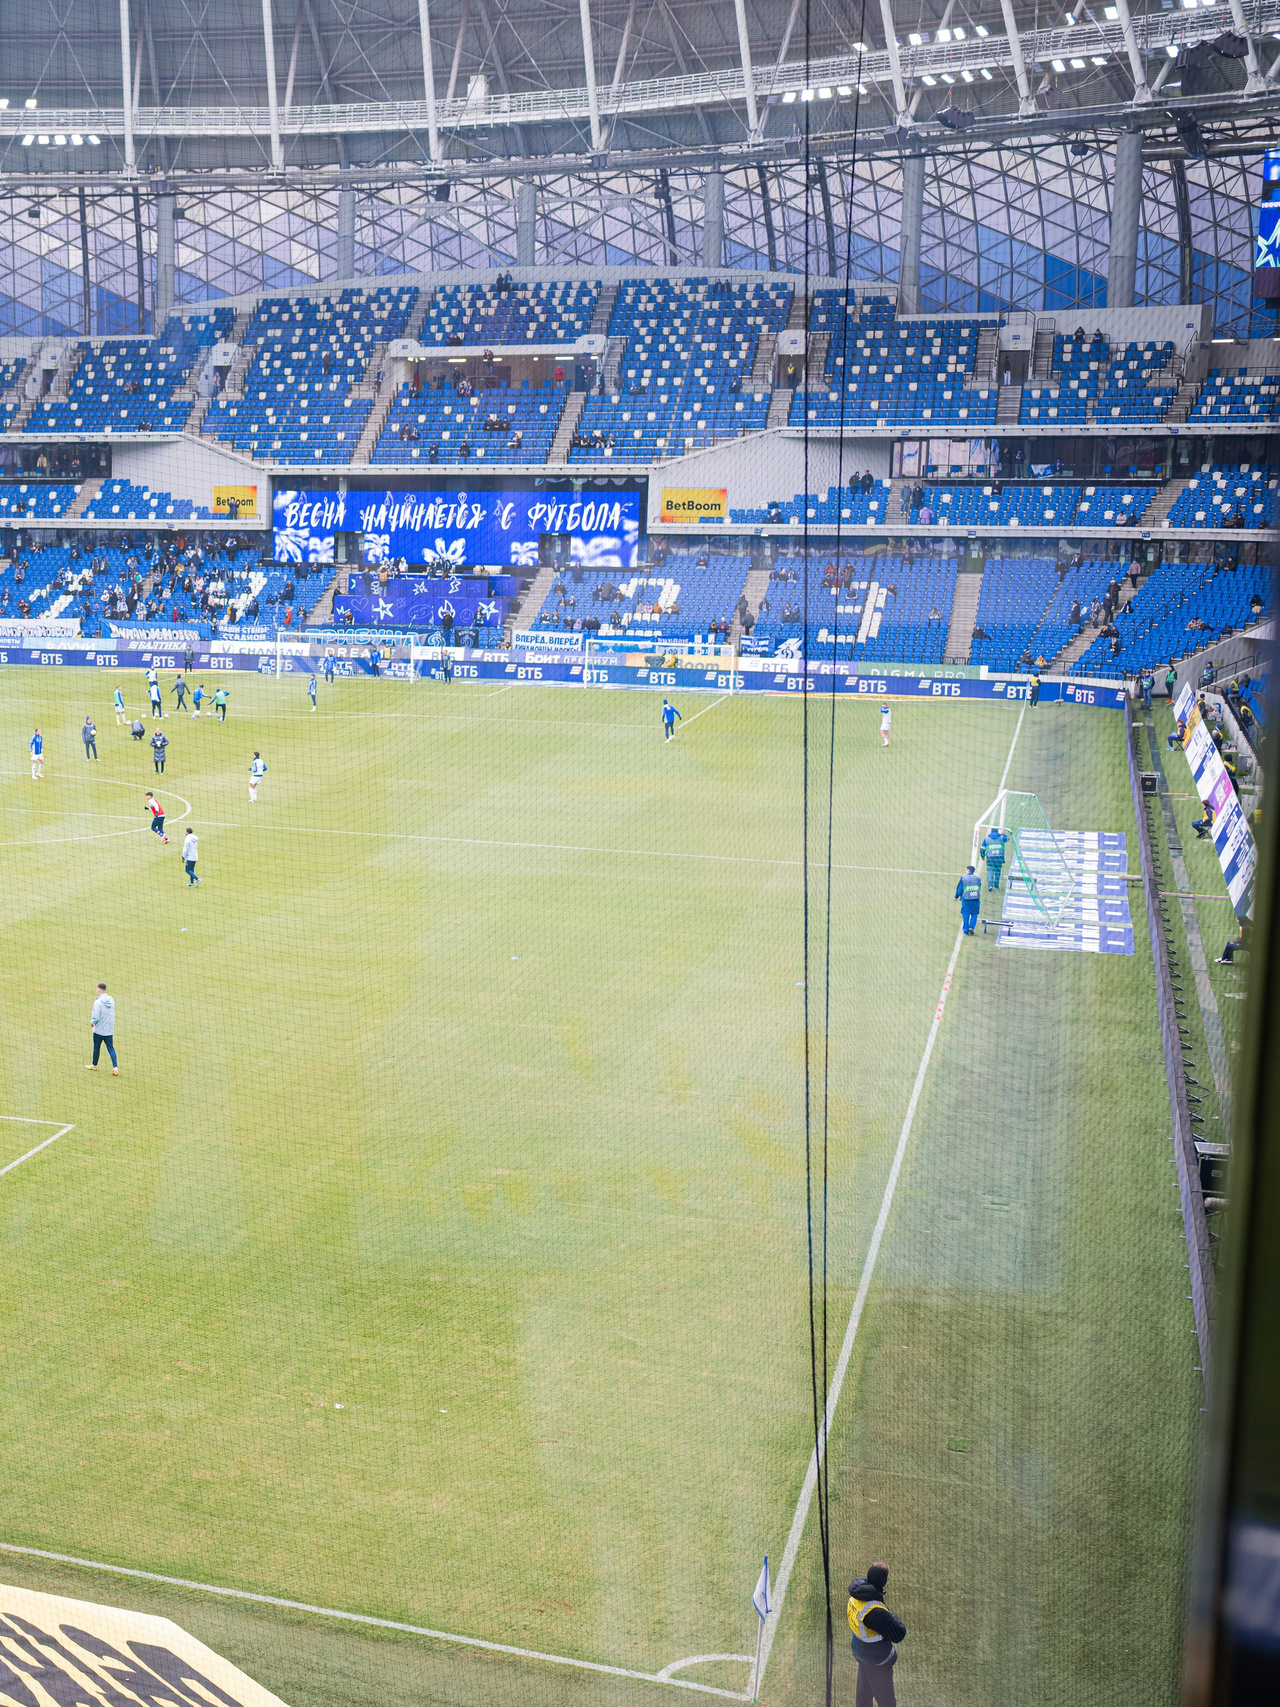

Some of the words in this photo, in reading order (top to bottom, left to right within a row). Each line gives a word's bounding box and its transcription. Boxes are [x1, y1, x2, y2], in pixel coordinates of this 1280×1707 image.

[666, 500, 721, 511] BetBoom
[286, 502, 345, 529] ВЕСНА
[363, 503, 481, 532] НАЧИНАЕТСЯ
[527, 502, 621, 531] ФУТБОЛА
[305, 628, 420, 646] ТРИБУНА
[515, 634, 549, 645] ВПЕРЁД,
[549, 635, 580, 646] ВПЕРЁД
[138, 641, 187, 650] БАЛТИКА
[41, 653, 63, 665] ВТБ
[96, 654, 118, 666] ВТБ
[152, 656, 175, 667] ВТБ
[432, 651, 456, 661] ВБ
[484, 652, 509, 662] ВТБ
[526, 651, 560, 663] Брит
[210, 657, 233, 669] ВТБ
[762, 663, 788, 673] ВТБ
[453, 665, 478, 677] ВТБ
[517, 666, 542, 679] ВТБ
[583, 668, 609, 682] ВТБ
[820, 664, 849, 675] ВТБ
[649, 671, 676, 684] ВТБ
[787, 677, 815, 691] ВТБ
[858, 679, 887, 693] ВТБ
[932, 682, 961, 696] ВТБ
[1075, 688, 1095, 704] ВТБ
